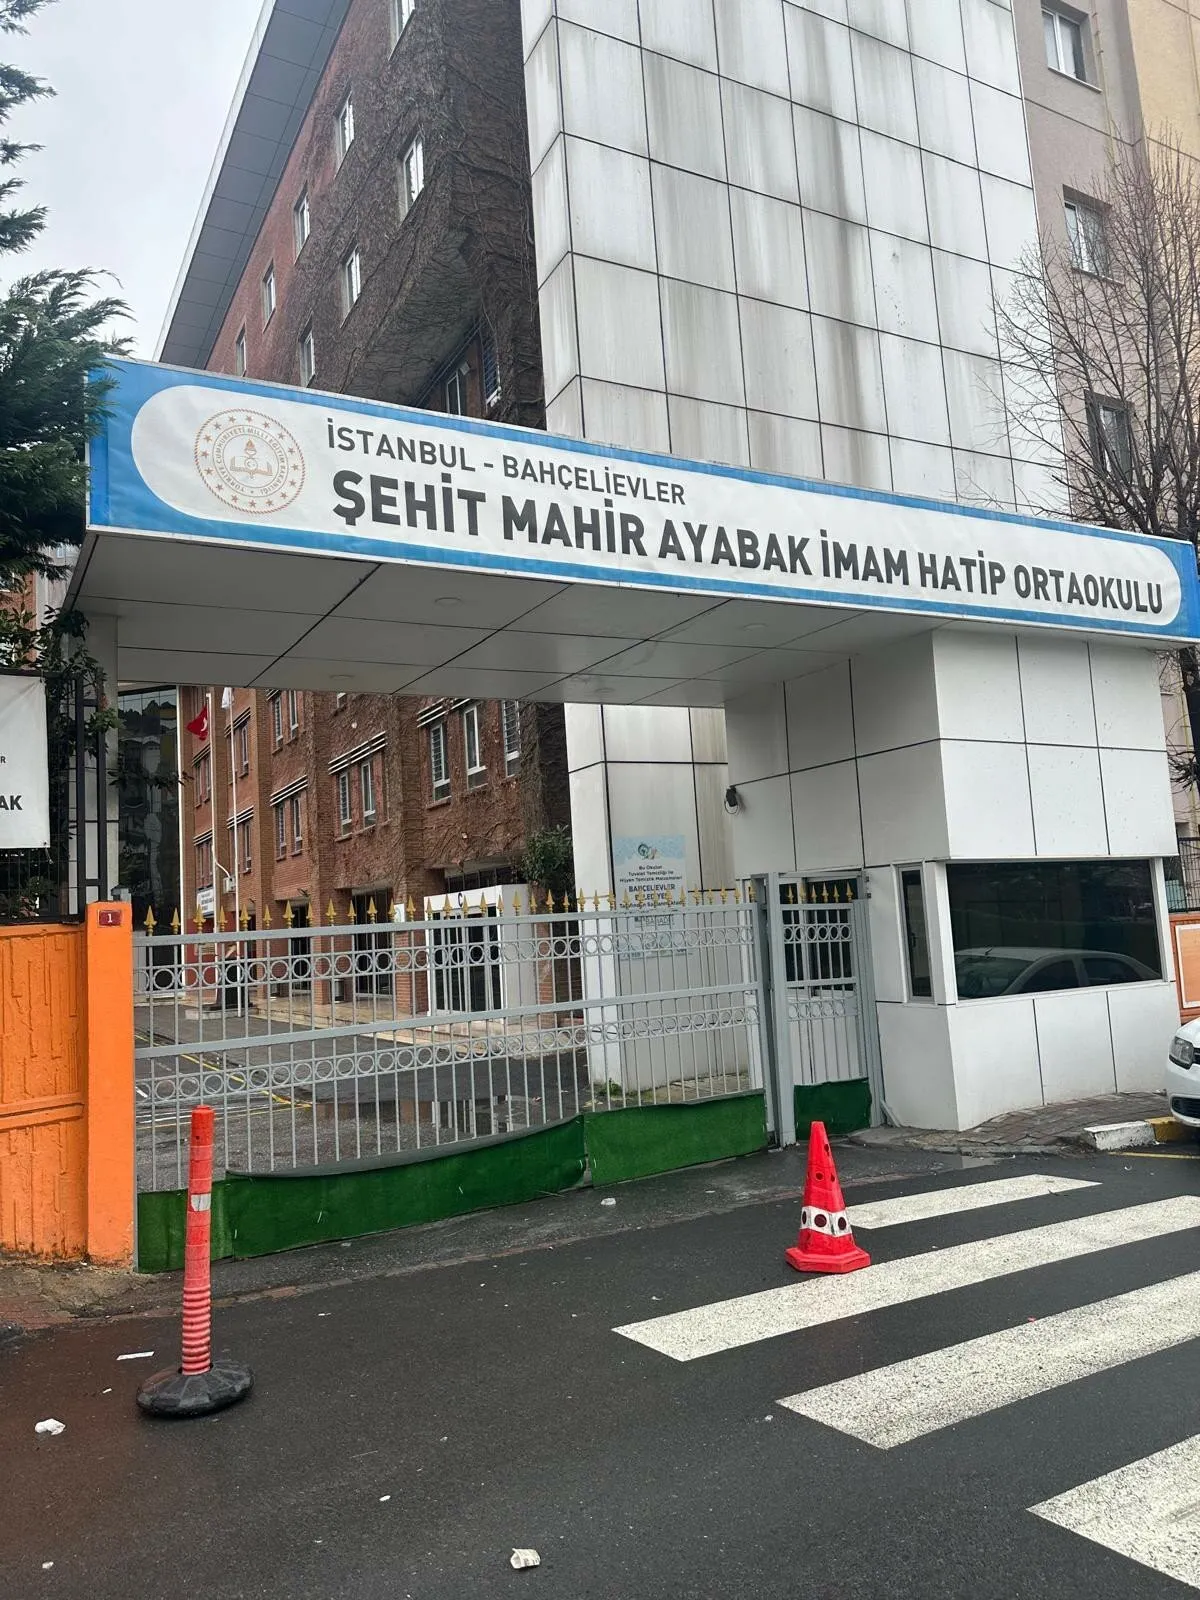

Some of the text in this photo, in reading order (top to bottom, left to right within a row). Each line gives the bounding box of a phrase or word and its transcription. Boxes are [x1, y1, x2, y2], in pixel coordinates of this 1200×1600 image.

[327, 417, 476, 472] İSTANBUL
[502, 454, 686, 506] BAHÇELİEVLER
[332, 469, 1163, 615] ŞEHİT MAHİR AYABAK İMAM HATİP ORTAOKULU
[107, 913, 113, 923] 1
